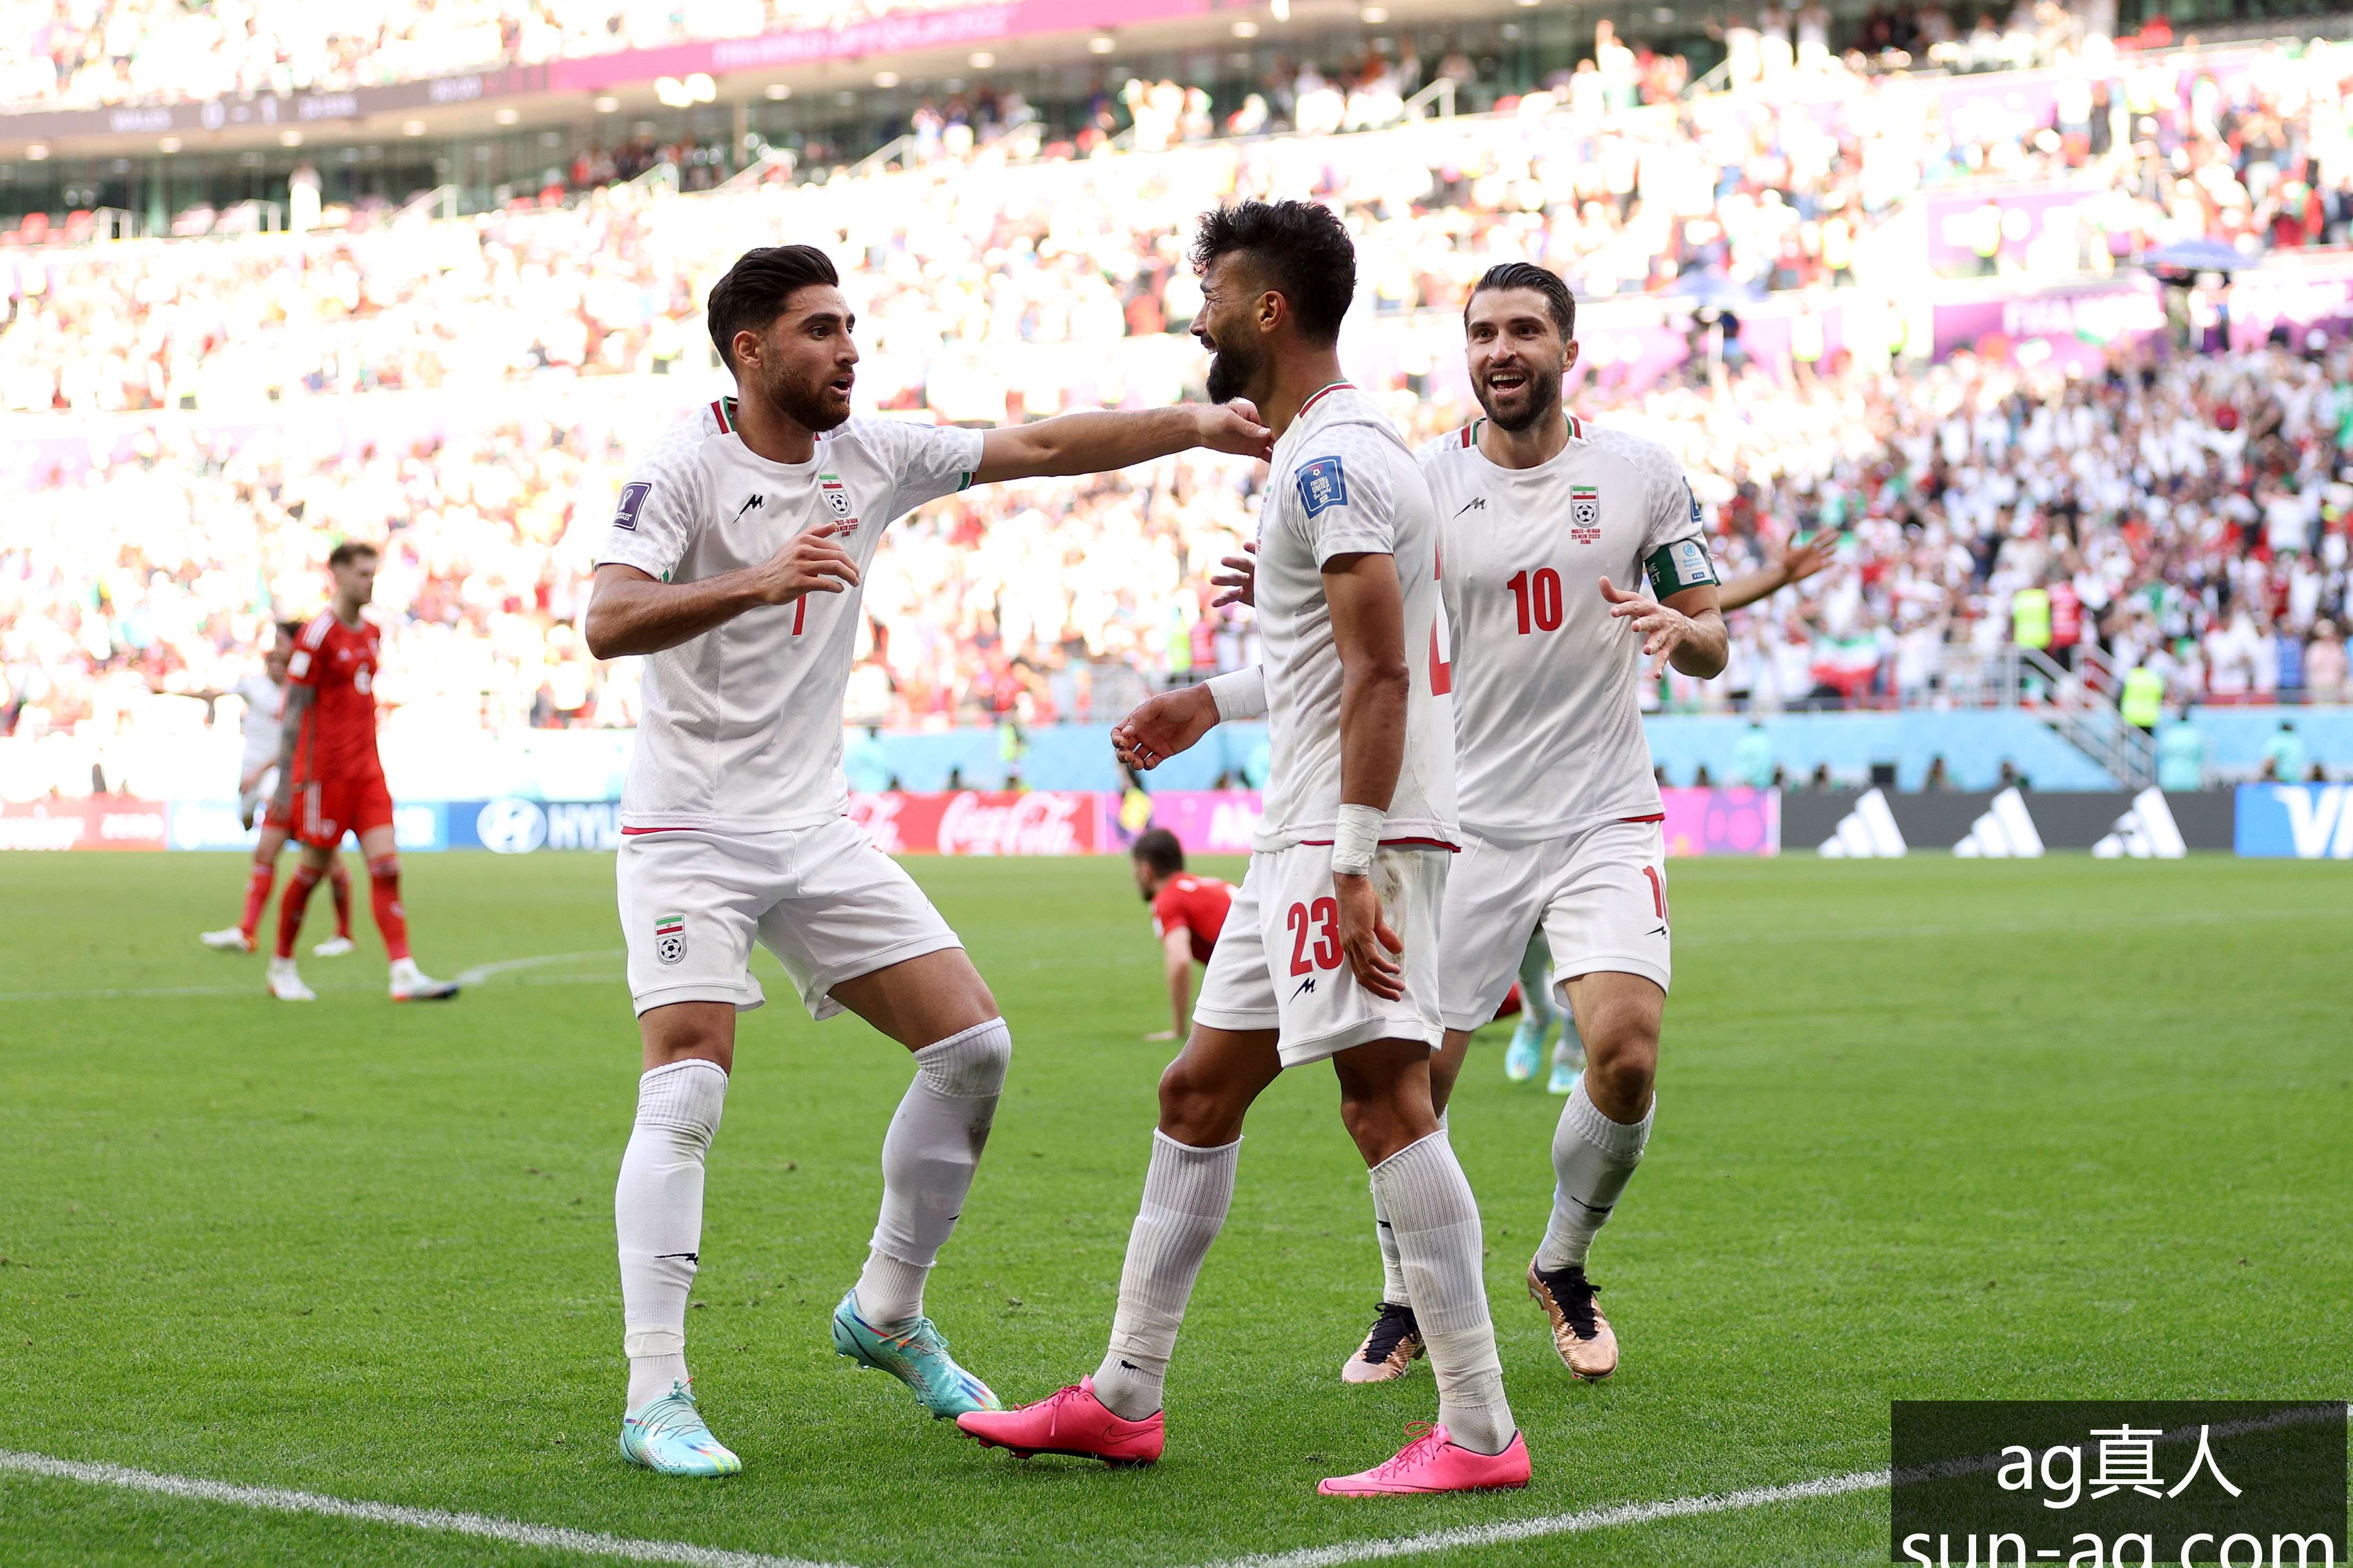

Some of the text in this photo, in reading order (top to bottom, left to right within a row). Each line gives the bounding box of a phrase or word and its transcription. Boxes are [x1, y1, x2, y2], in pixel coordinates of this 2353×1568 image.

[1312, 480, 1329, 493] UNITES
[1507, 568, 1562, 635] 10
[1287, 897, 1344, 976] 23
